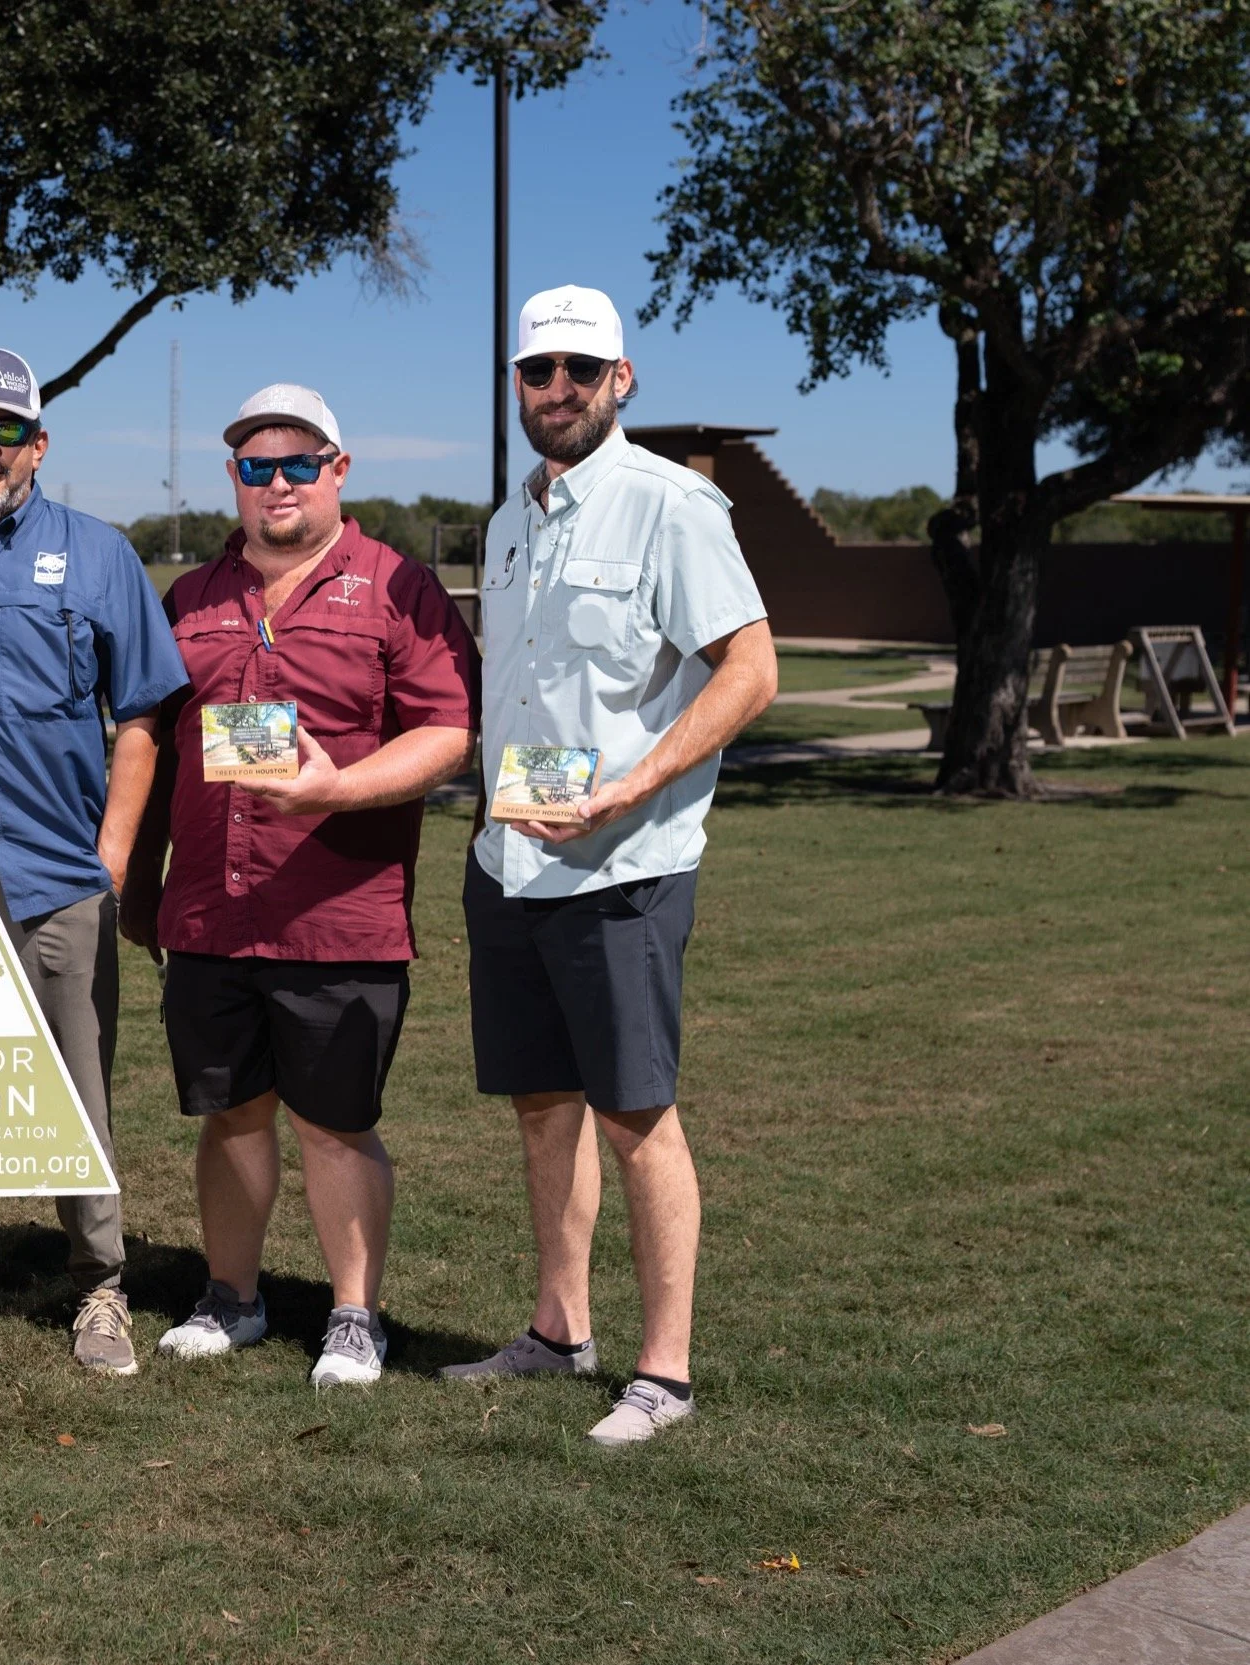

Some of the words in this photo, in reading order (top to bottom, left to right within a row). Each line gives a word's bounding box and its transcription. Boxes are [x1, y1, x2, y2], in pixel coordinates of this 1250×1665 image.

[531, 319, 551, 330] Ranch
[551, 316, 597, 328] Management
[542, 810, 575, 818] HOUSTON
